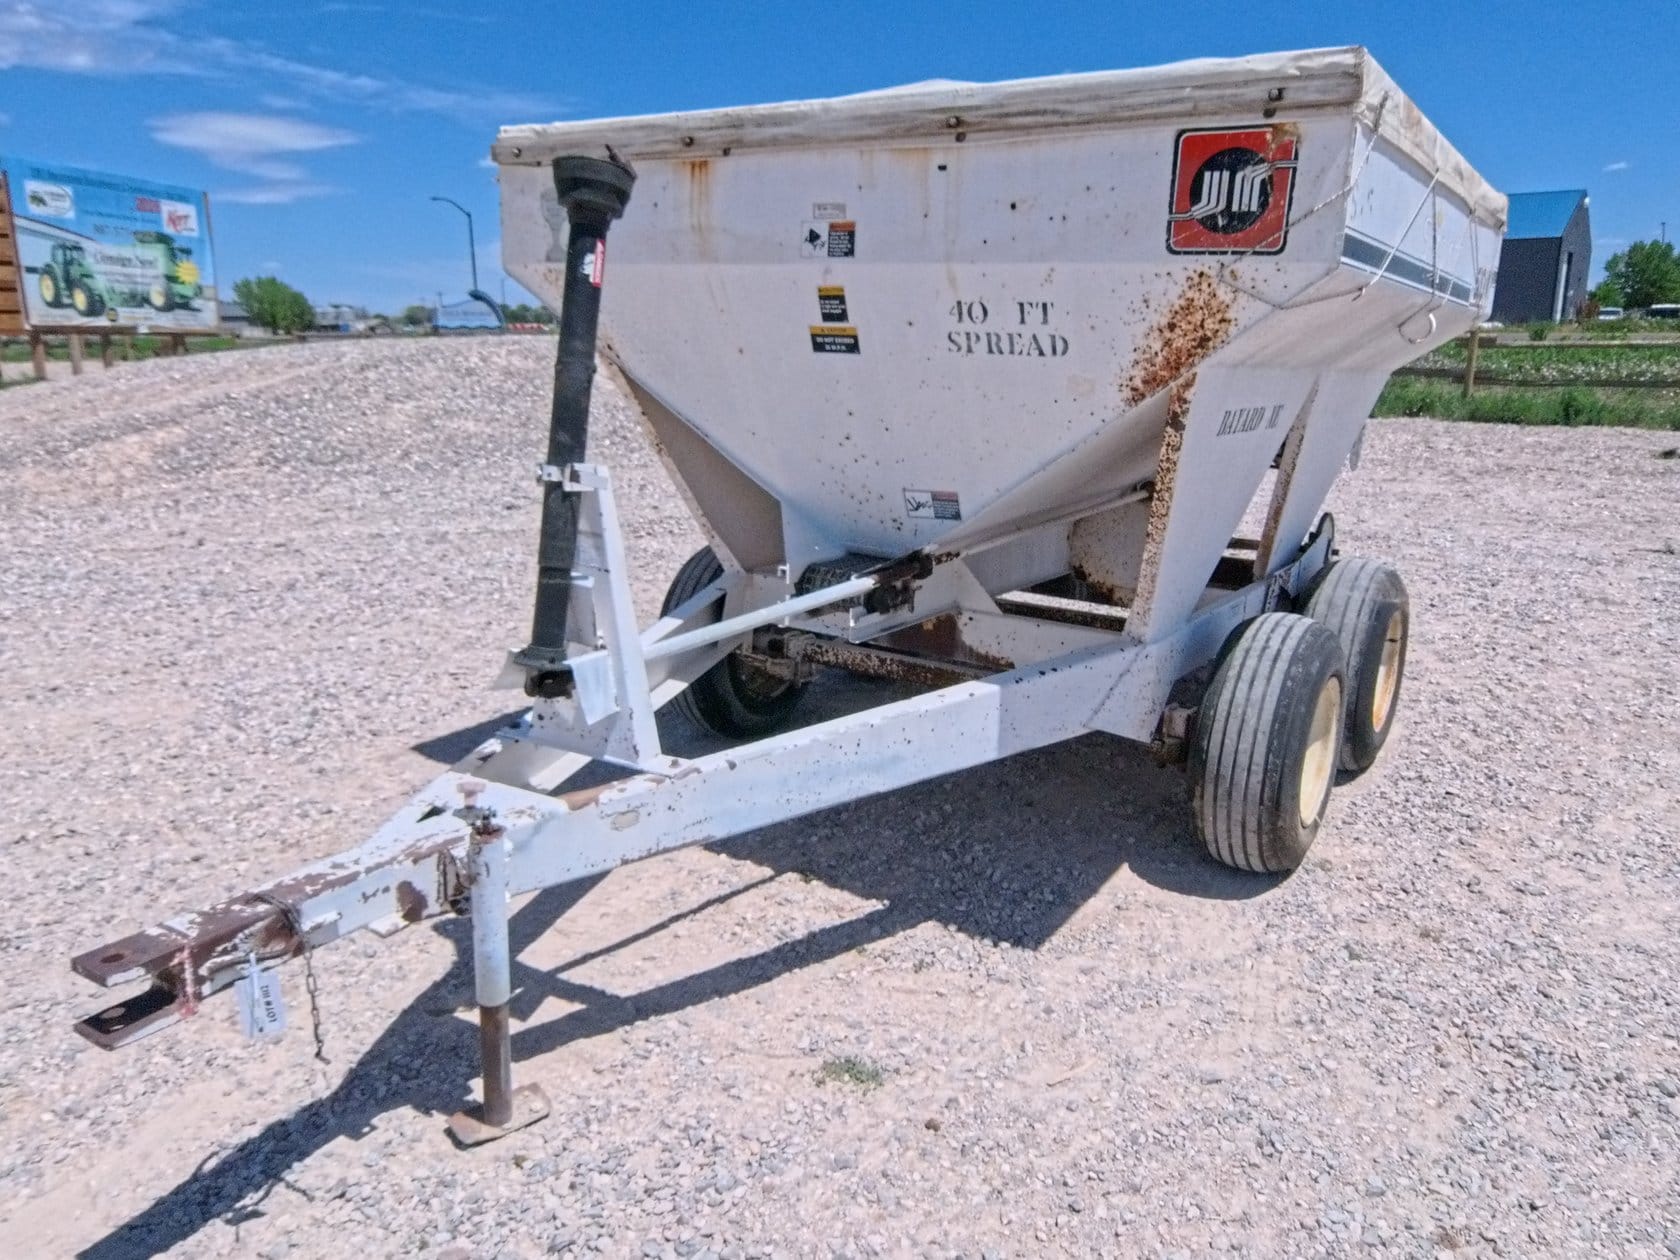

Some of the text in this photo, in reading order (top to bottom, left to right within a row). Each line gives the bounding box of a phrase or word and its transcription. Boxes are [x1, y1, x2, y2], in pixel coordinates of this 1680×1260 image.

[948, 299, 1054, 325] 40 FT
[947, 331, 1069, 357] SPREAD
